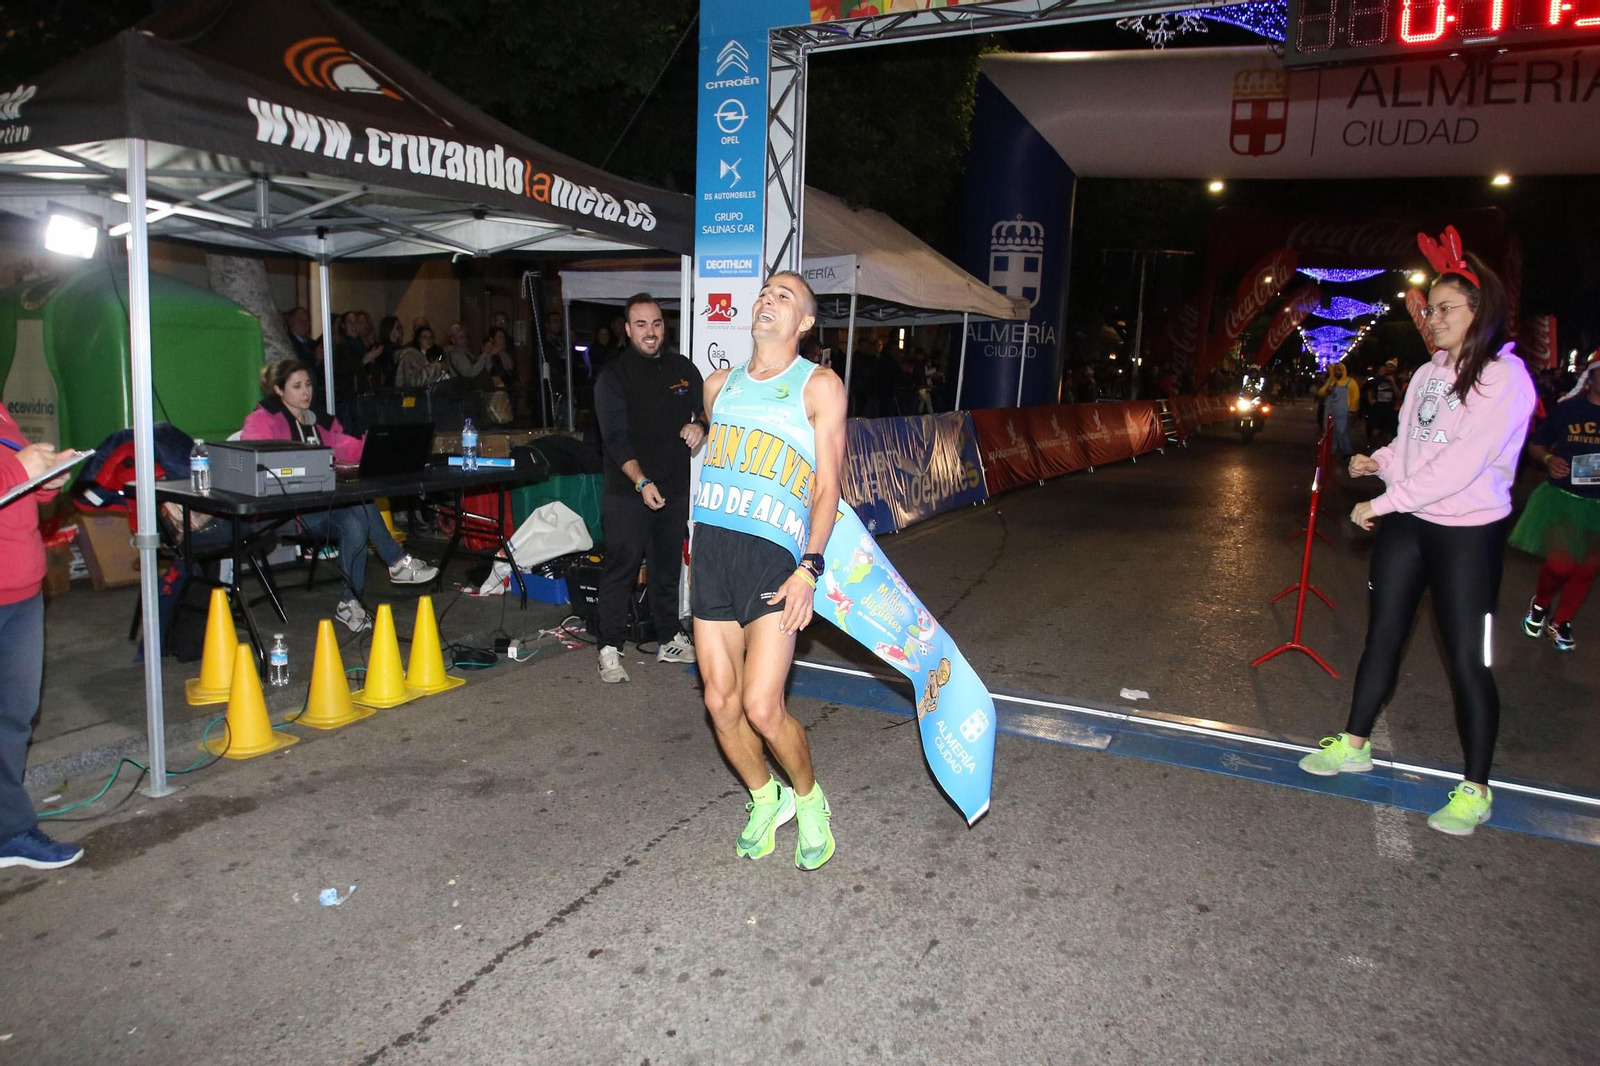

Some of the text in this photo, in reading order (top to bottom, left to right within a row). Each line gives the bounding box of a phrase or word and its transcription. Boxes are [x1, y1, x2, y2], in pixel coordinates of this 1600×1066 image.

[720, 136, 740, 145] OPEL
[1342, 117, 1479, 148] CIUDAD
[247, 97, 657, 232] www.cruzandolameta.es
[714, 191, 756, 200] AUTOMOBILES
[714, 212, 743, 221] GRUPO
[702, 224, 754, 234] SALINAS CAR
[706, 259, 752, 270] DECATHLON
[1225, 252, 1291, 339] Coca-Cola
[966, 321, 1056, 345] ALMERÍA
[984, 345, 1037, 358] CIUDAD
[1410, 426, 1449, 443] ISA
[1568, 421, 1600, 434] UC
[703, 422, 816, 508] SAN SILVES
[724, 485, 756, 518] DE
[935, 736, 962, 774] CIUDAD
[936, 720, 976, 774] ALMERÍA
